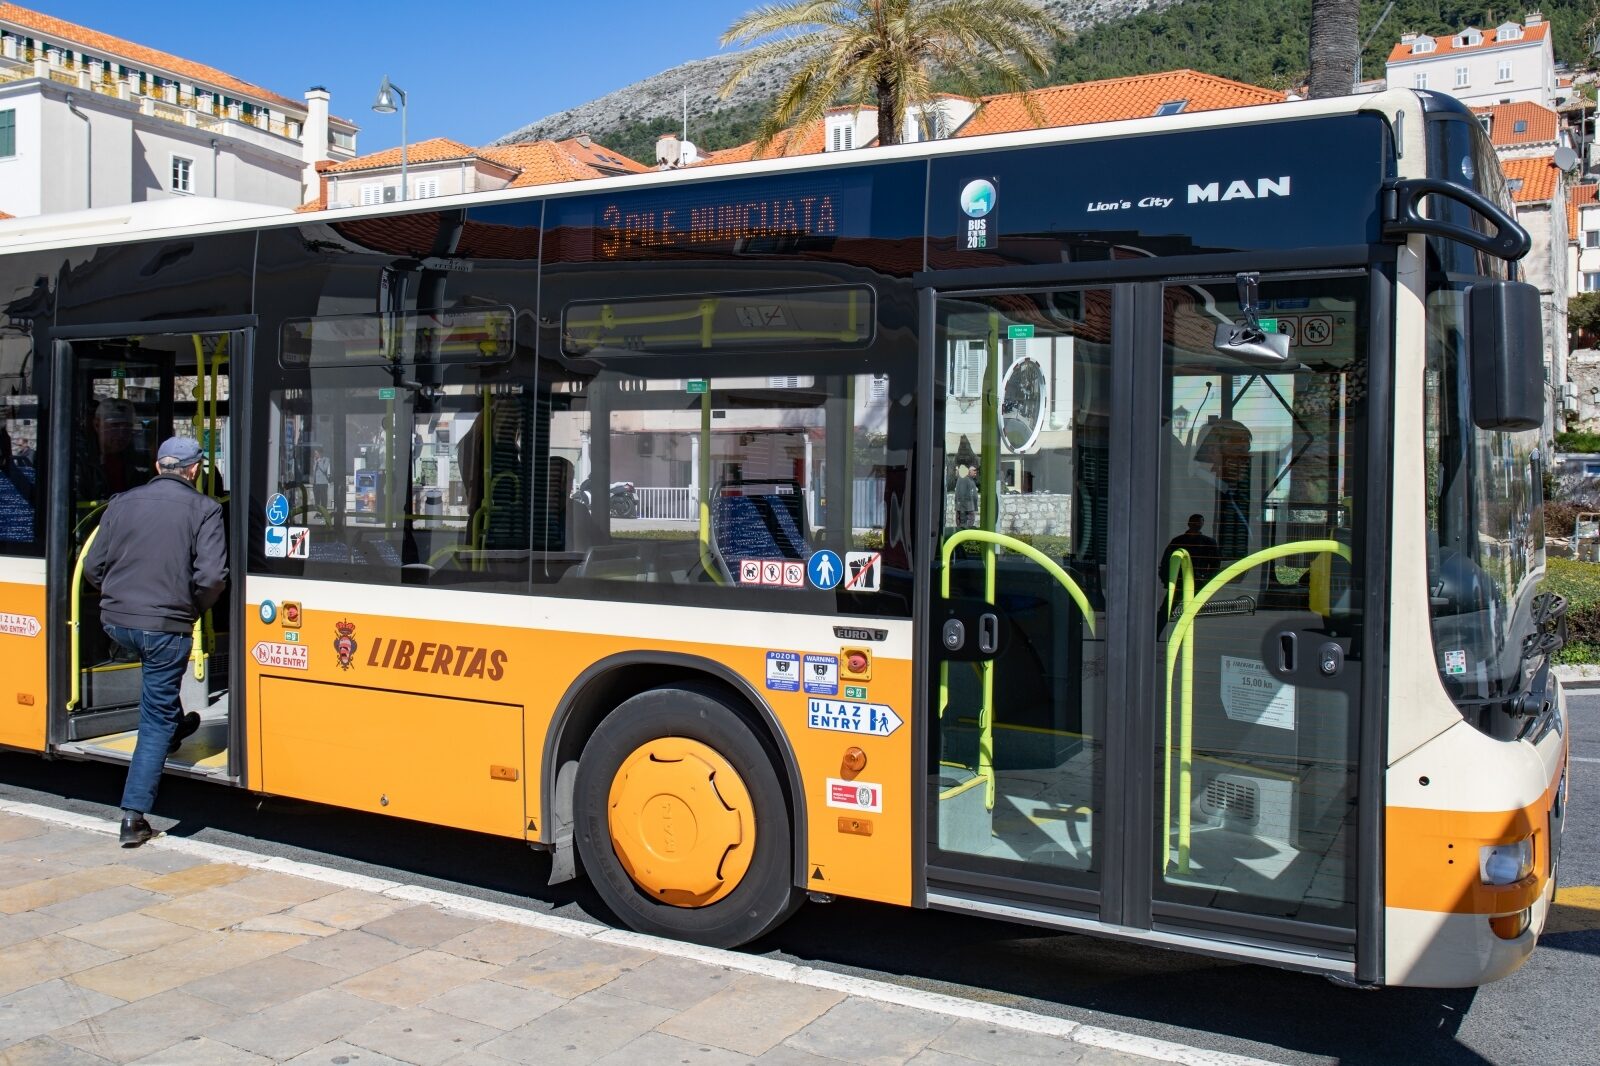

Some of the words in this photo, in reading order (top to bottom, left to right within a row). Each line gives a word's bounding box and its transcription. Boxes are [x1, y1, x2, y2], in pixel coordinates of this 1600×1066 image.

[1087, 200, 1131, 212] Lion's
[1137, 196, 1173, 208] City
[1187, 175, 1291, 204] MAN
[968, 219, 986, 230] BUS
[603, 205, 620, 257] 3
[967, 235, 986, 248] 2015
[9, 625, 27, 634] ENTRY
[838, 629, 868, 639] EURO
[270, 644, 306, 657] IZLAZ
[770, 652, 796, 660] POZOR
[270, 655, 281, 665] NO
[282, 657, 306, 667] ENTRY
[366, 637, 508, 682] LIBERTAS
[806, 655, 835, 663] WARNING
[1242, 677, 1263, 688] 15,00
[1263, 679, 1273, 689] kn
[811, 701, 861, 717] ULAZ
[811, 714, 861, 731] ENTRY
